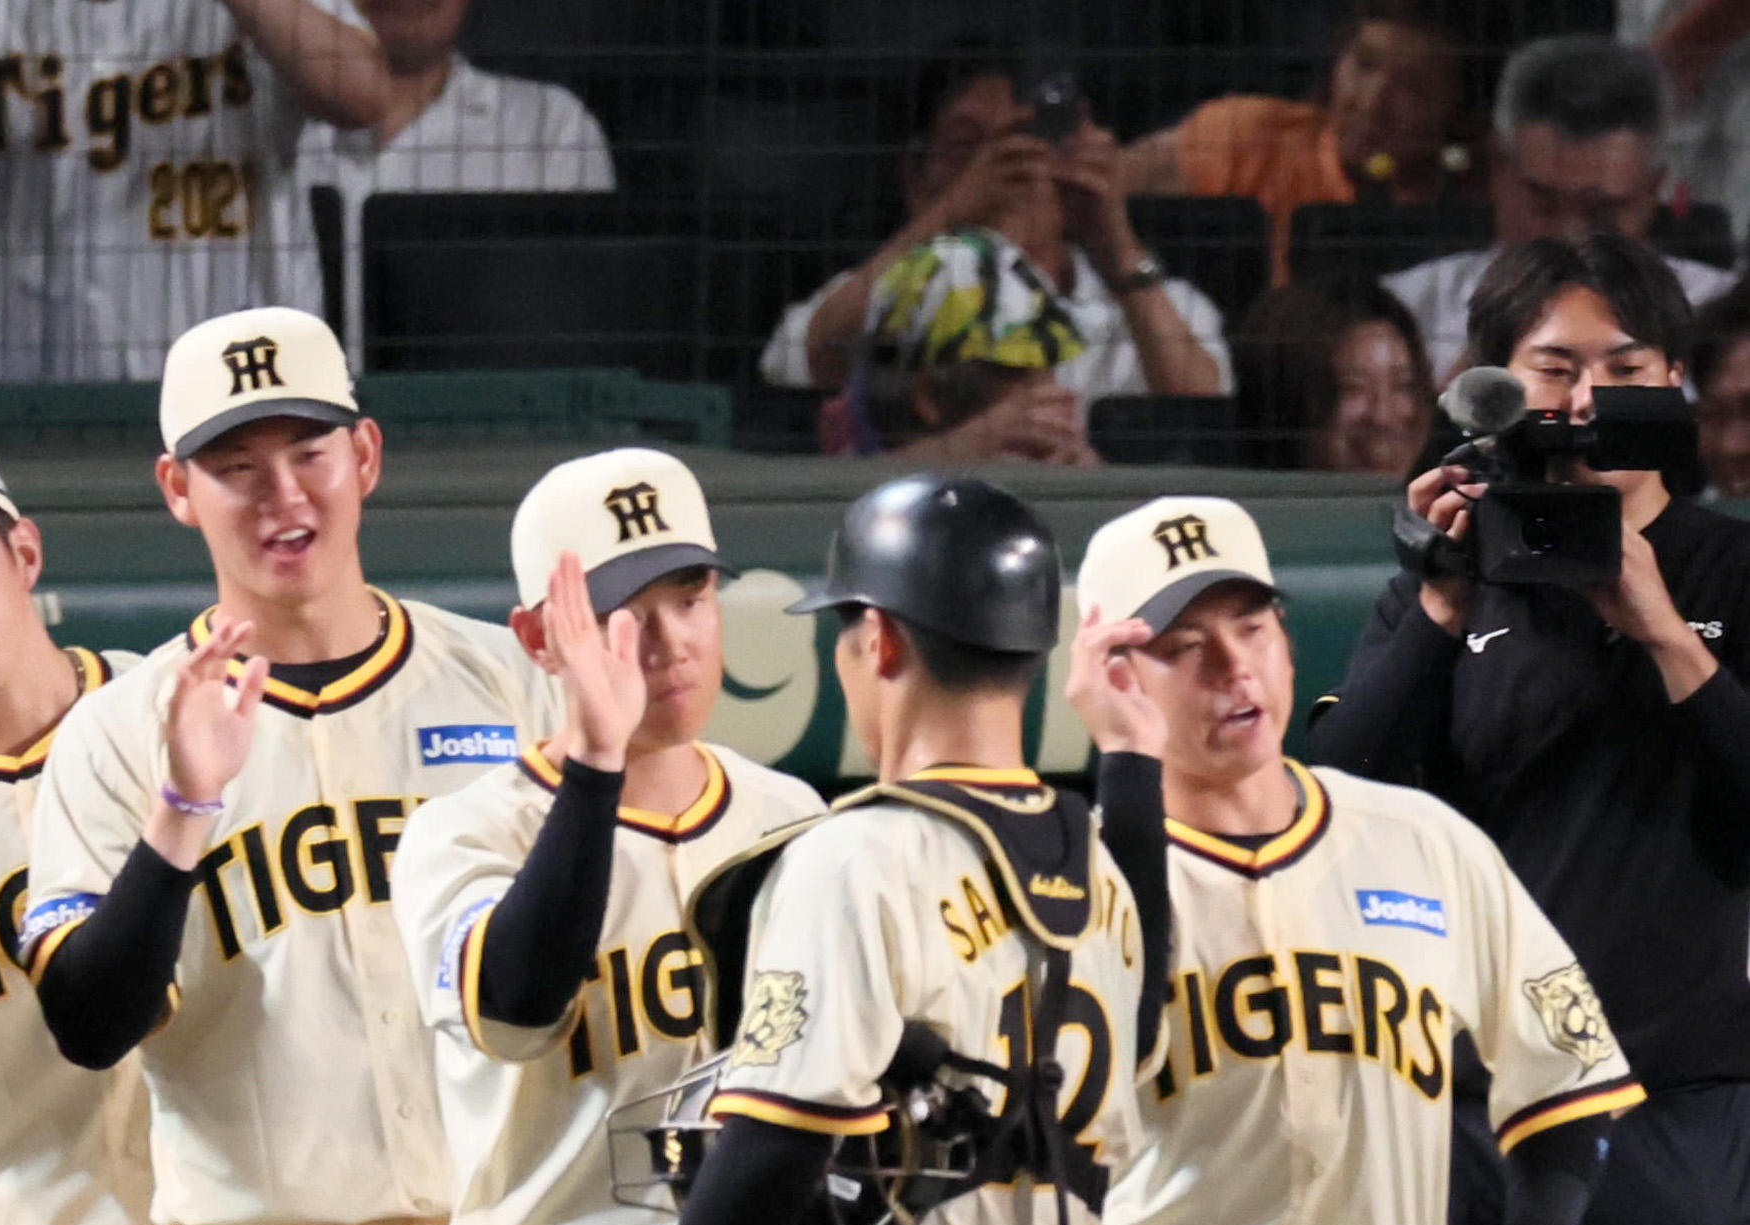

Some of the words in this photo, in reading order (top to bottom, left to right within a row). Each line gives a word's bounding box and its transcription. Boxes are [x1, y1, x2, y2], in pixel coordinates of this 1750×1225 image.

[422, 731, 518, 759] Joshin
[196, 795, 432, 963] TIGE
[1362, 894, 1446, 930] Joshin
